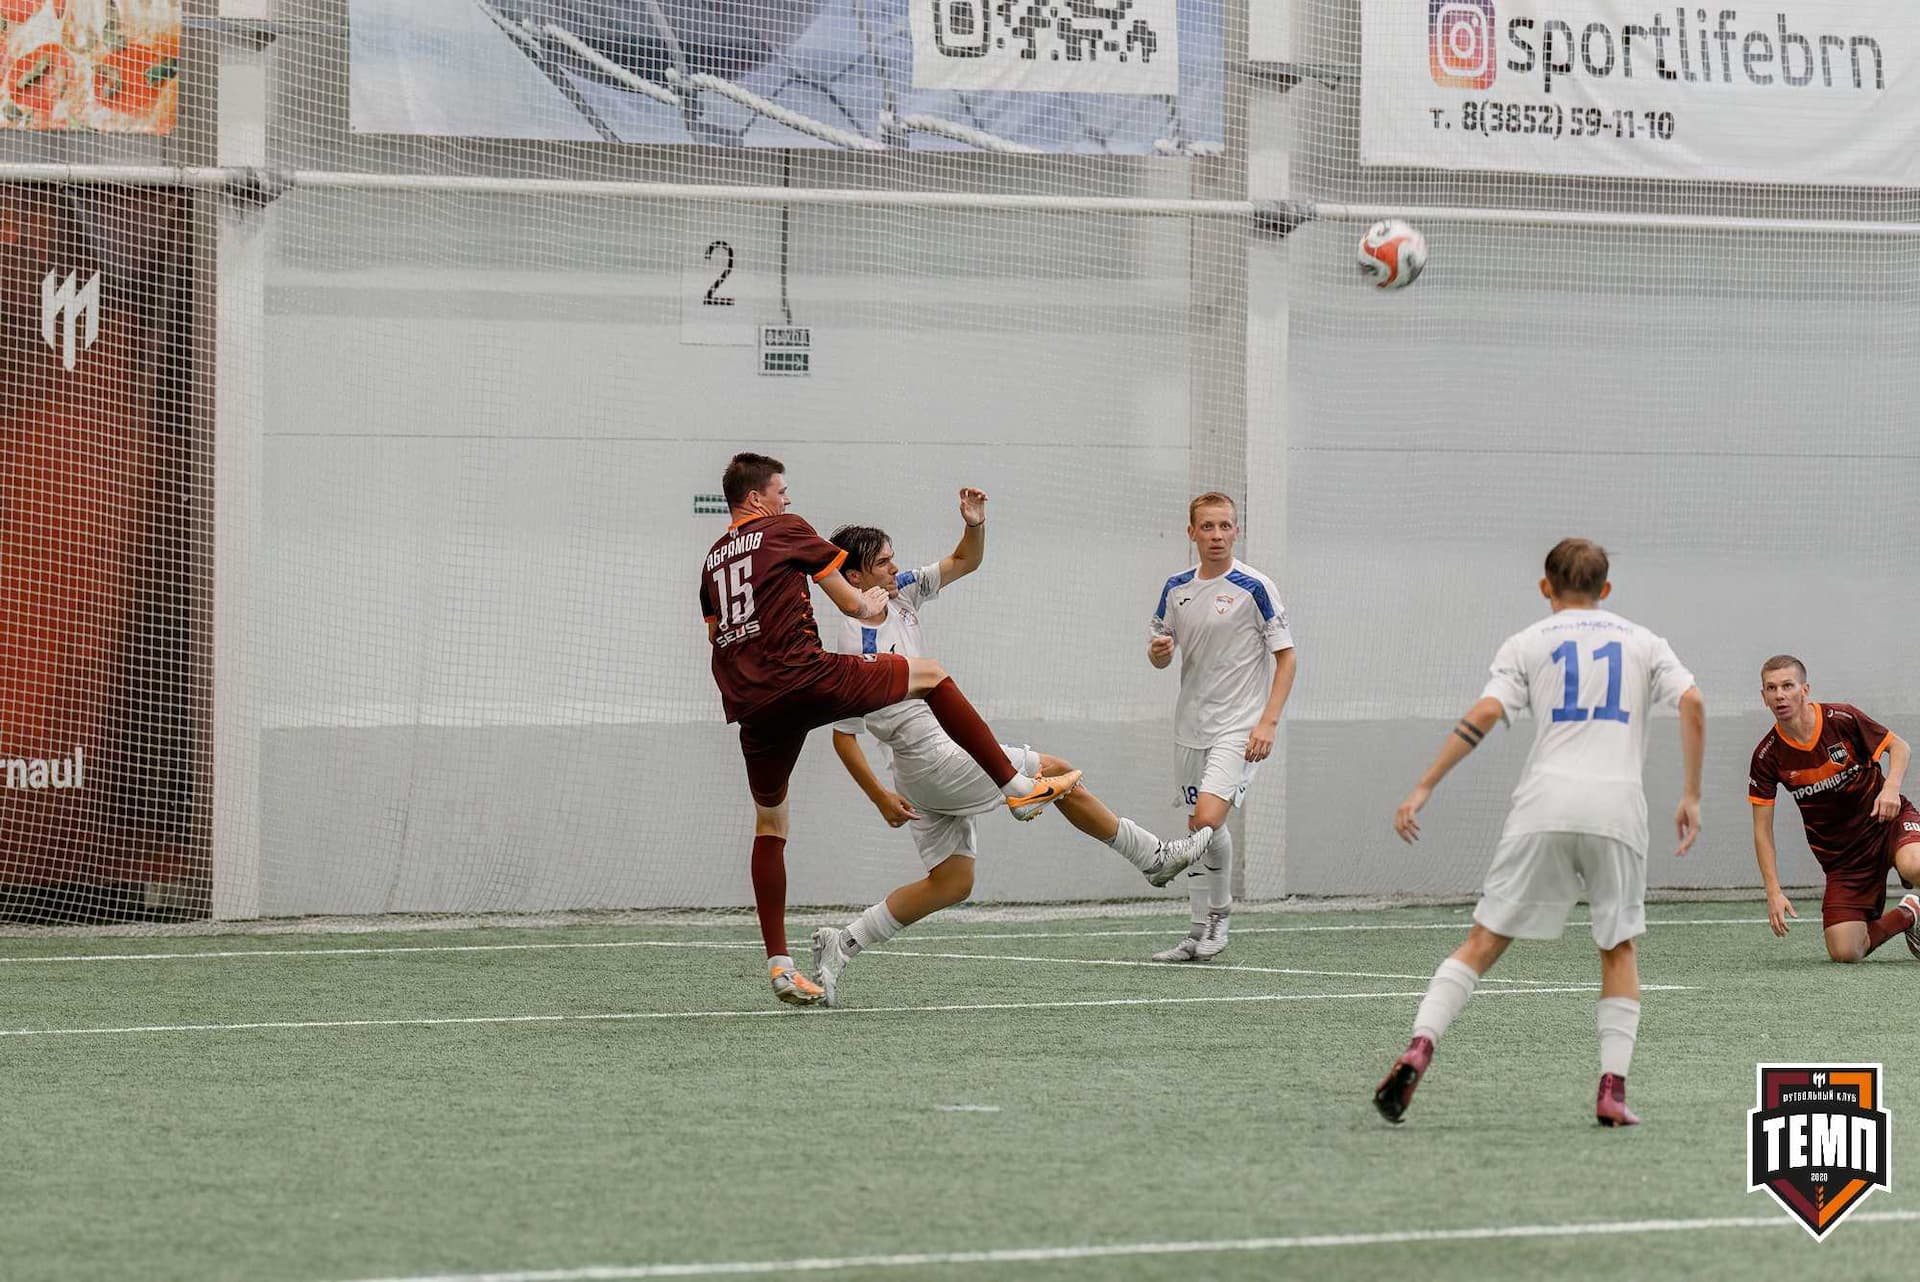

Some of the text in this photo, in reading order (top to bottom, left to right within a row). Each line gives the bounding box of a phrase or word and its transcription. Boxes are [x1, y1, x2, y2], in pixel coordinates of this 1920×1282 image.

[1507, 7, 1885, 93] sportlifebrn
[1462, 100, 1564, 140] 8(3852)
[1570, 107, 1675, 141] 59-11-10
[703, 240, 736, 306] 2
[706, 532, 763, 572] АБРАМОВ
[713, 555, 755, 631] 15
[1552, 640, 1631, 724] 11
